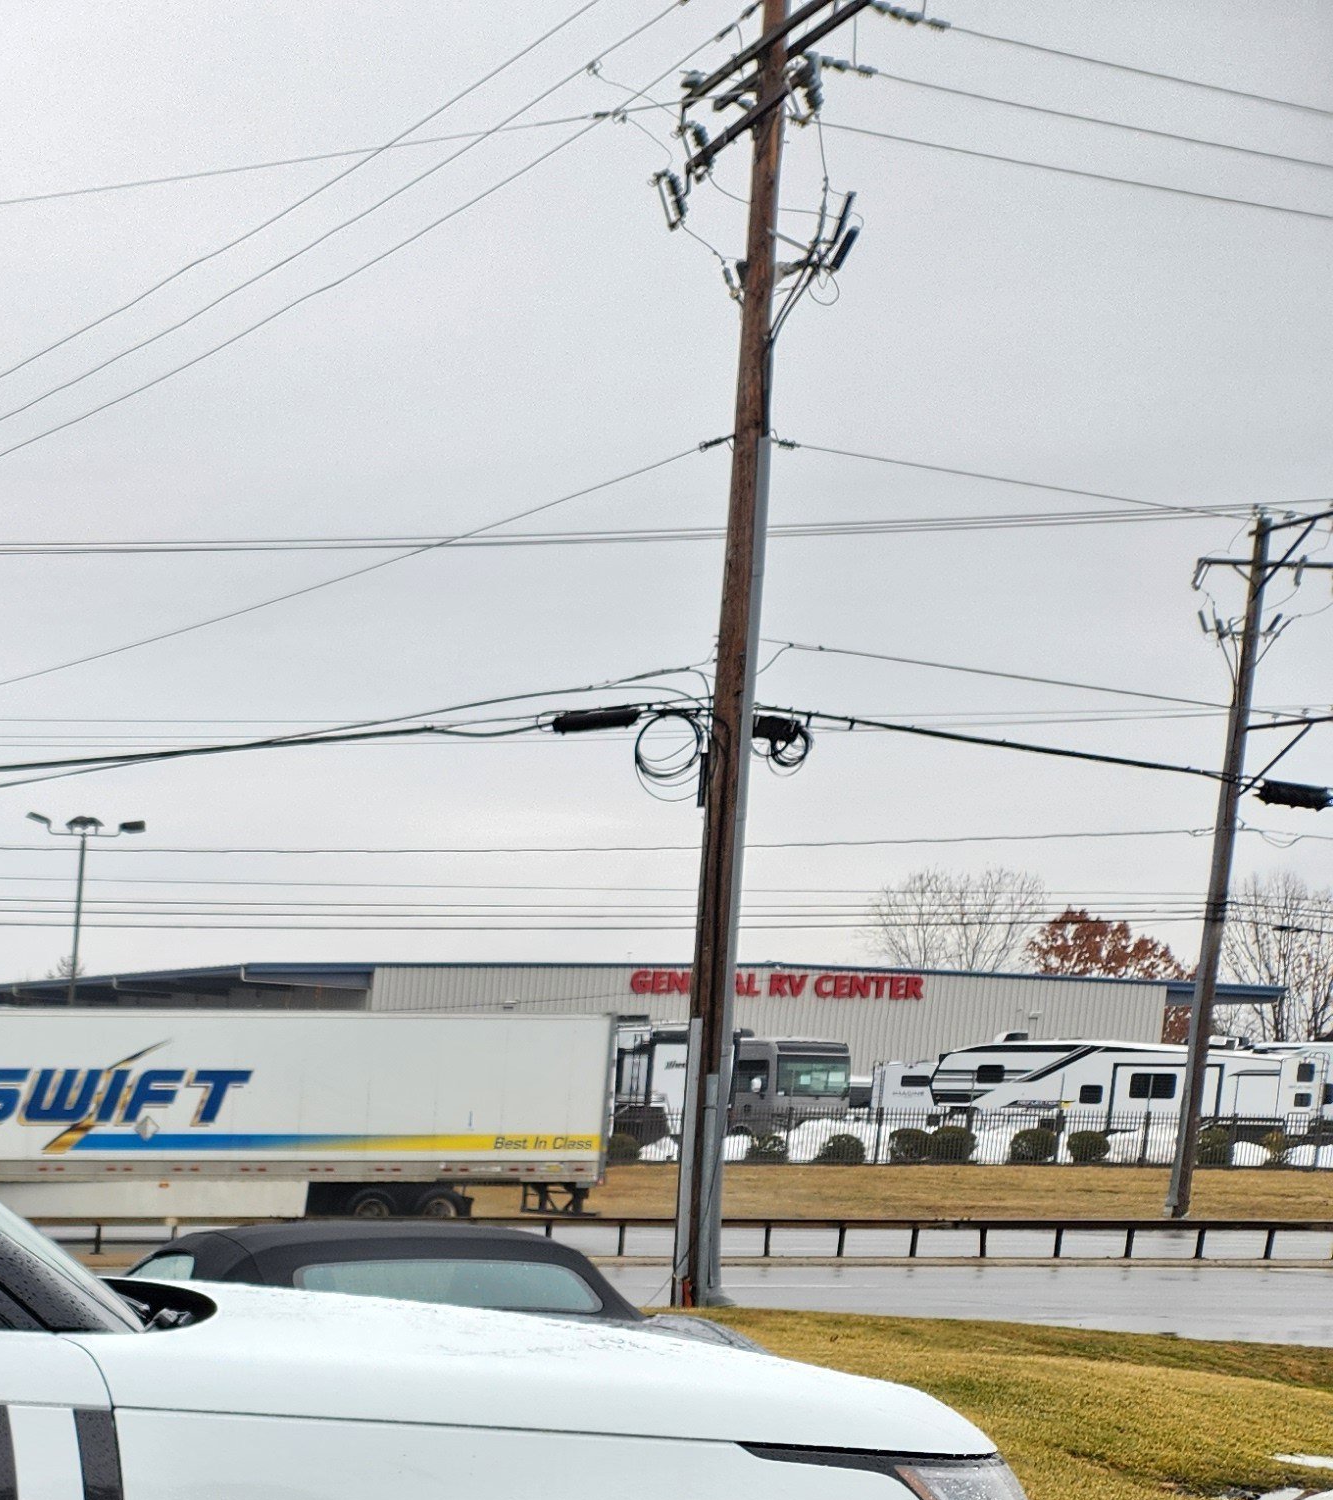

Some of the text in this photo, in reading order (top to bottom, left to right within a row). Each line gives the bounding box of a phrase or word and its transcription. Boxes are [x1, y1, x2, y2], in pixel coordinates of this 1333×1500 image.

[631, 969, 923, 1000] GENAL RV CENTER
[493, 1136, 593, 1150] Best In Class
